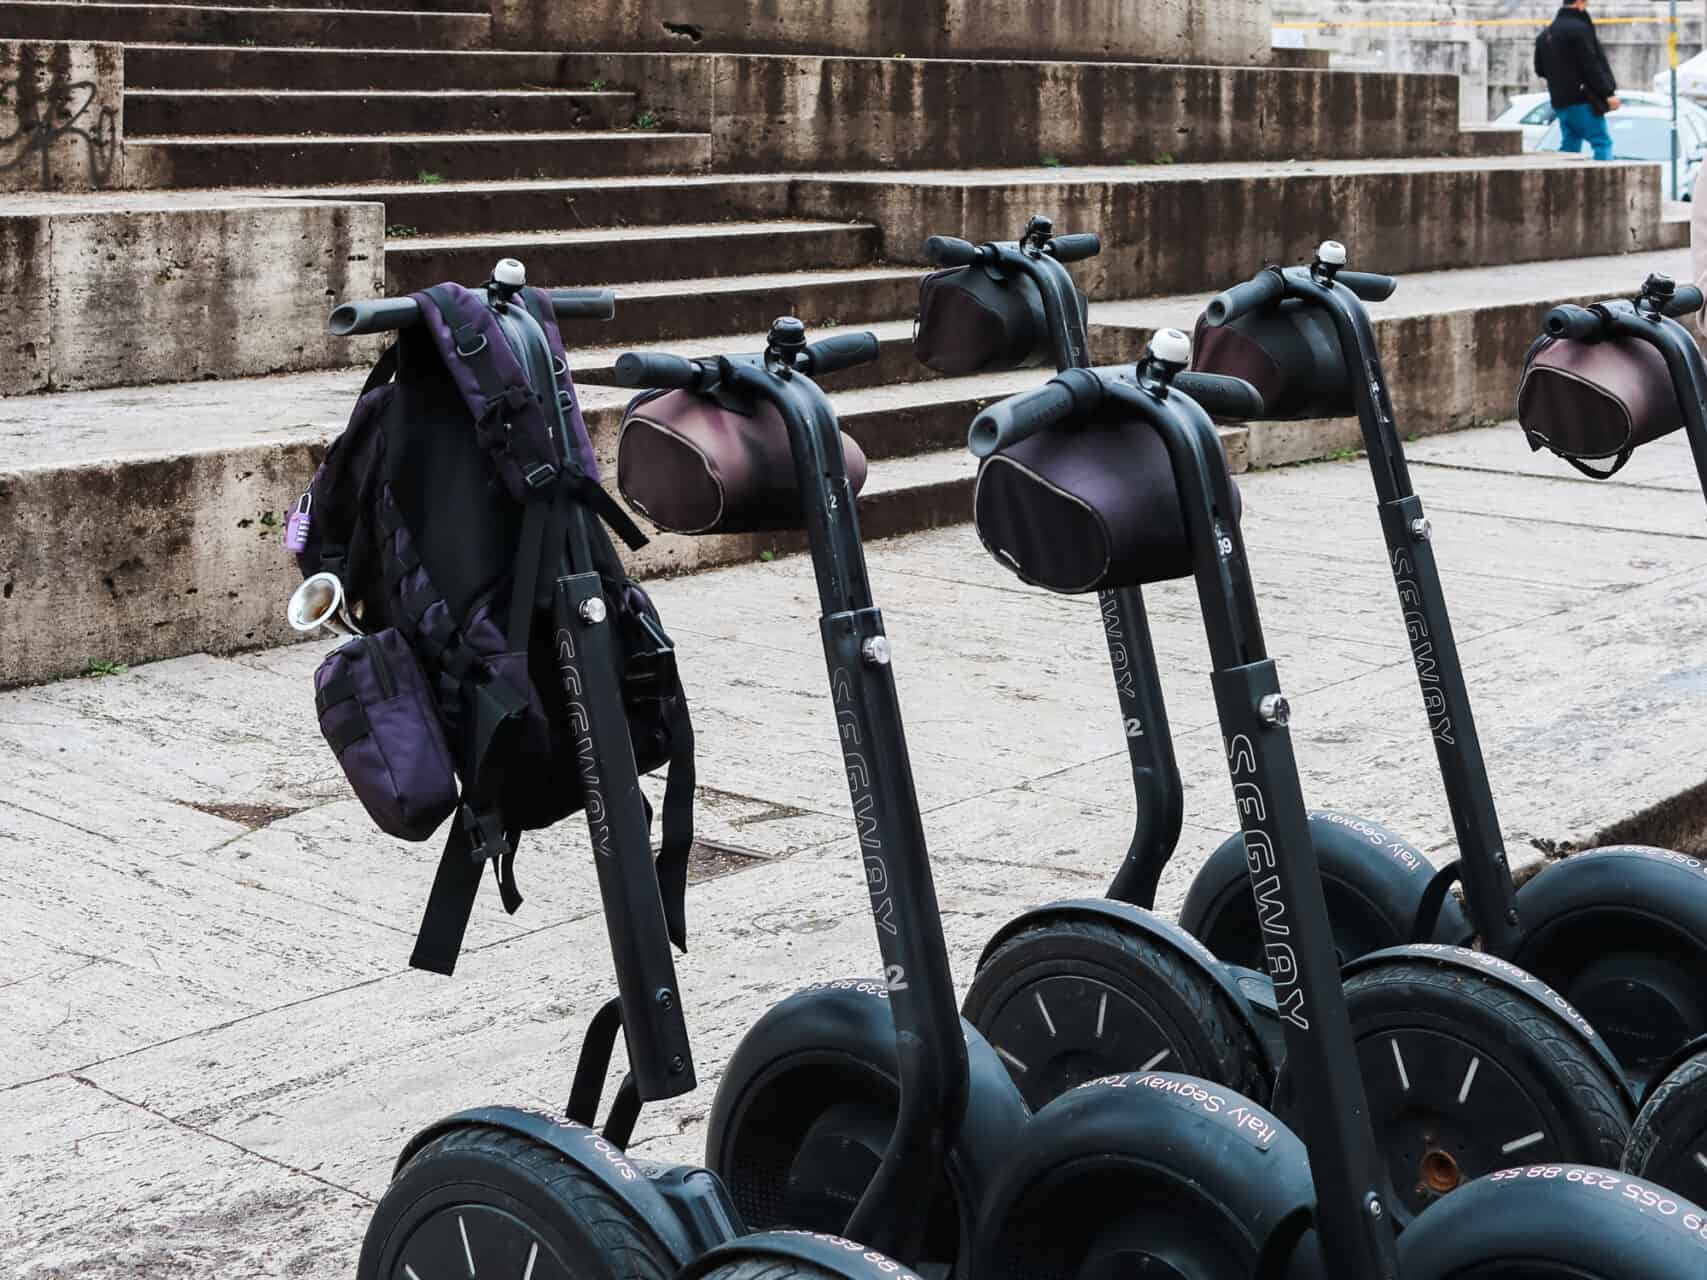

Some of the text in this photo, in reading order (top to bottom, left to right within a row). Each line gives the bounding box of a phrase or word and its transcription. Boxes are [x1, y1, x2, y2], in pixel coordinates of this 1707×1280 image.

[1099, 585, 1136, 699] WAY
[1388, 546, 1455, 745] SEGWAY
[555, 627, 612, 857] SEGWAY
[832, 666, 897, 936] SEGWAY
[1387, 842, 1422, 871] Italy
[1223, 733, 1309, 1030] SEGWAY
[1136, 1073, 1226, 1113] Segway
[1226, 1107, 1277, 1144] Italy
[1490, 1167, 1524, 1182] 55
[1527, 1165, 1562, 1179] 88
[1566, 1168, 1622, 1190] 239
